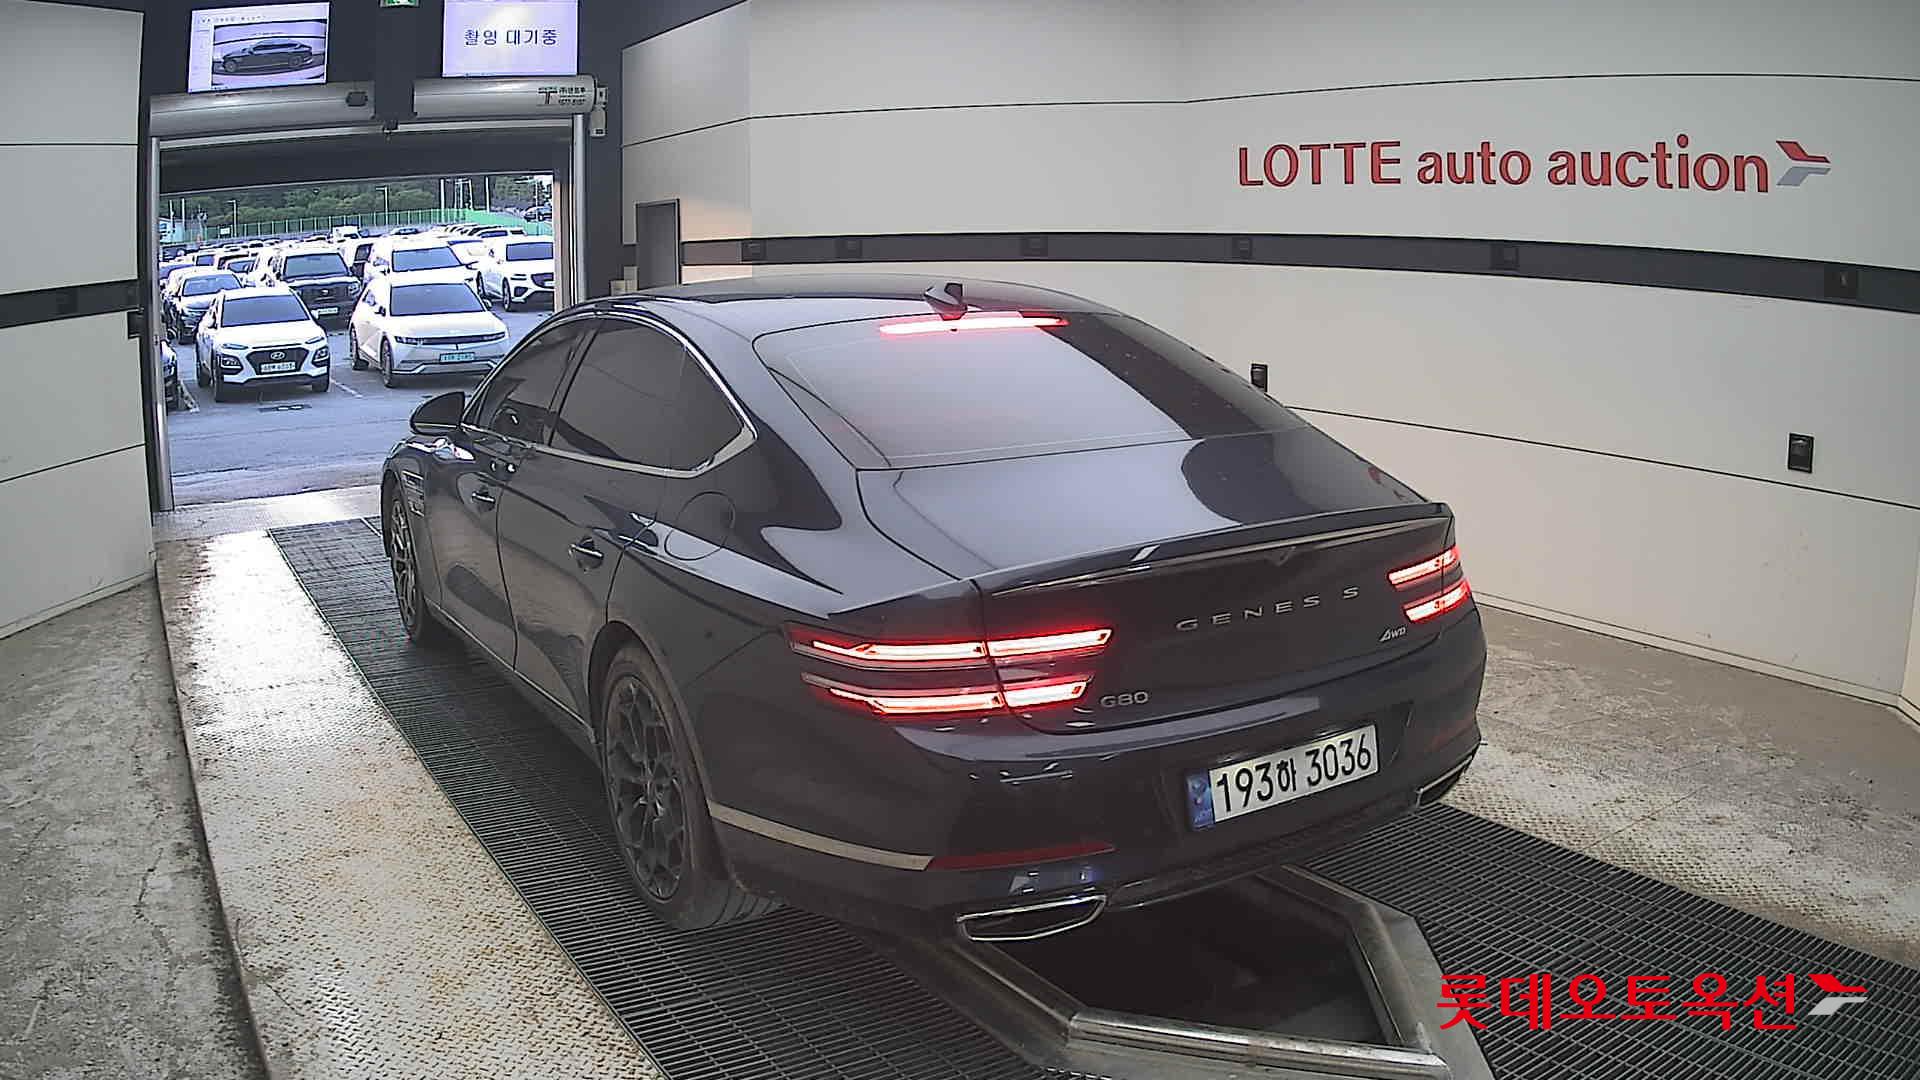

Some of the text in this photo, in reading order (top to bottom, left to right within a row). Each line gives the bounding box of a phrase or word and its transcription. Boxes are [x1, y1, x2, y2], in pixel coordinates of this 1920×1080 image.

[464, 29, 558, 46] 촬영 대기중
[1238, 134, 1769, 193] LOTTE auto auction
[1175, 586, 1359, 632] GENESS
[1100, 691, 1149, 708] G80
[1216, 734, 1371, 812] 193하 3036
